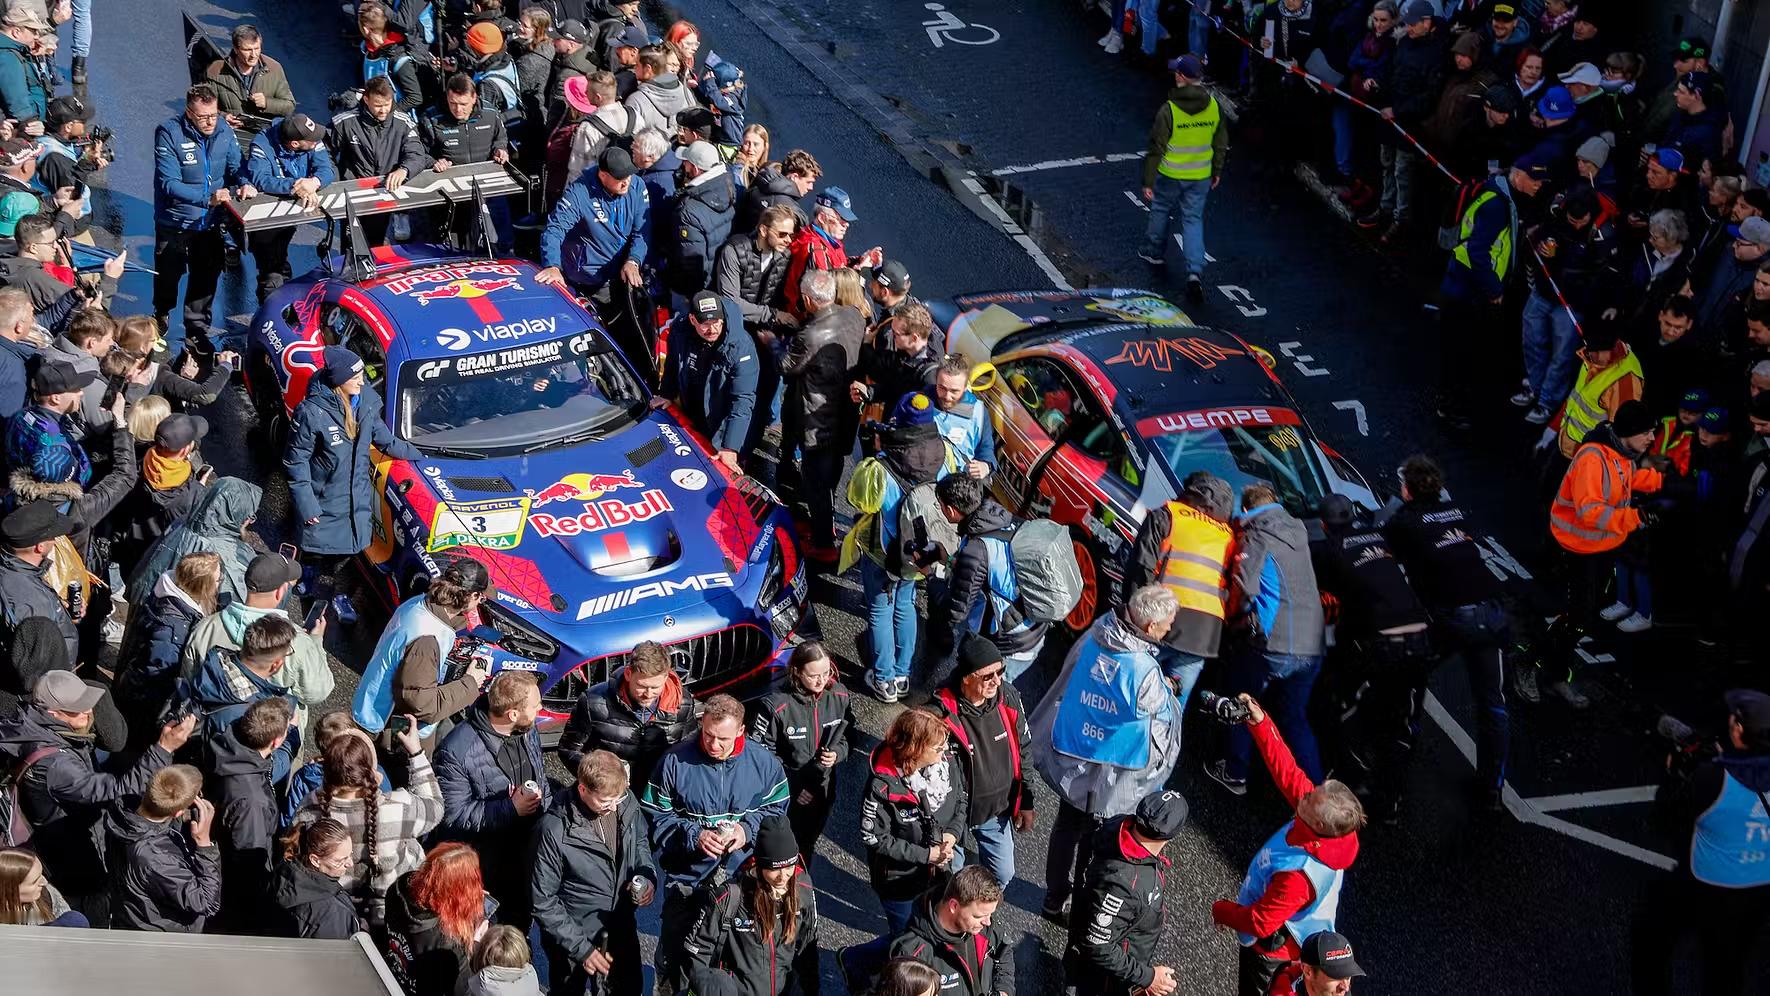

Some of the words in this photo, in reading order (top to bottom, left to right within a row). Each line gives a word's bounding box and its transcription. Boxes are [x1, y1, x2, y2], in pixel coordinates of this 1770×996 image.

[267, 329, 285, 354] viaplay
[472, 316, 557, 343] viaplay
[456, 353, 498, 372] GRAN
[499, 342, 563, 364] TURISMO
[474, 367, 493, 375] REAL
[494, 362, 523, 373] DRIVING
[523, 354, 563, 368] SIMULATOR
[1156, 408, 1273, 433] WEMPE
[657, 423, 683, 451] viaplay
[433, 476, 457, 501] viaplay
[451, 501, 518, 512] RAVENOL
[530, 503, 601, 538] Red
[597, 489, 673, 528] Bull
[471, 516, 488, 533] 3
[457, 534, 511, 548] DEKRA
[628, 571, 734, 605] AMG
[502, 660, 538, 671] sparco
[1080, 690, 1118, 715] MEDIA
[1082, 722, 1105, 741] 866
